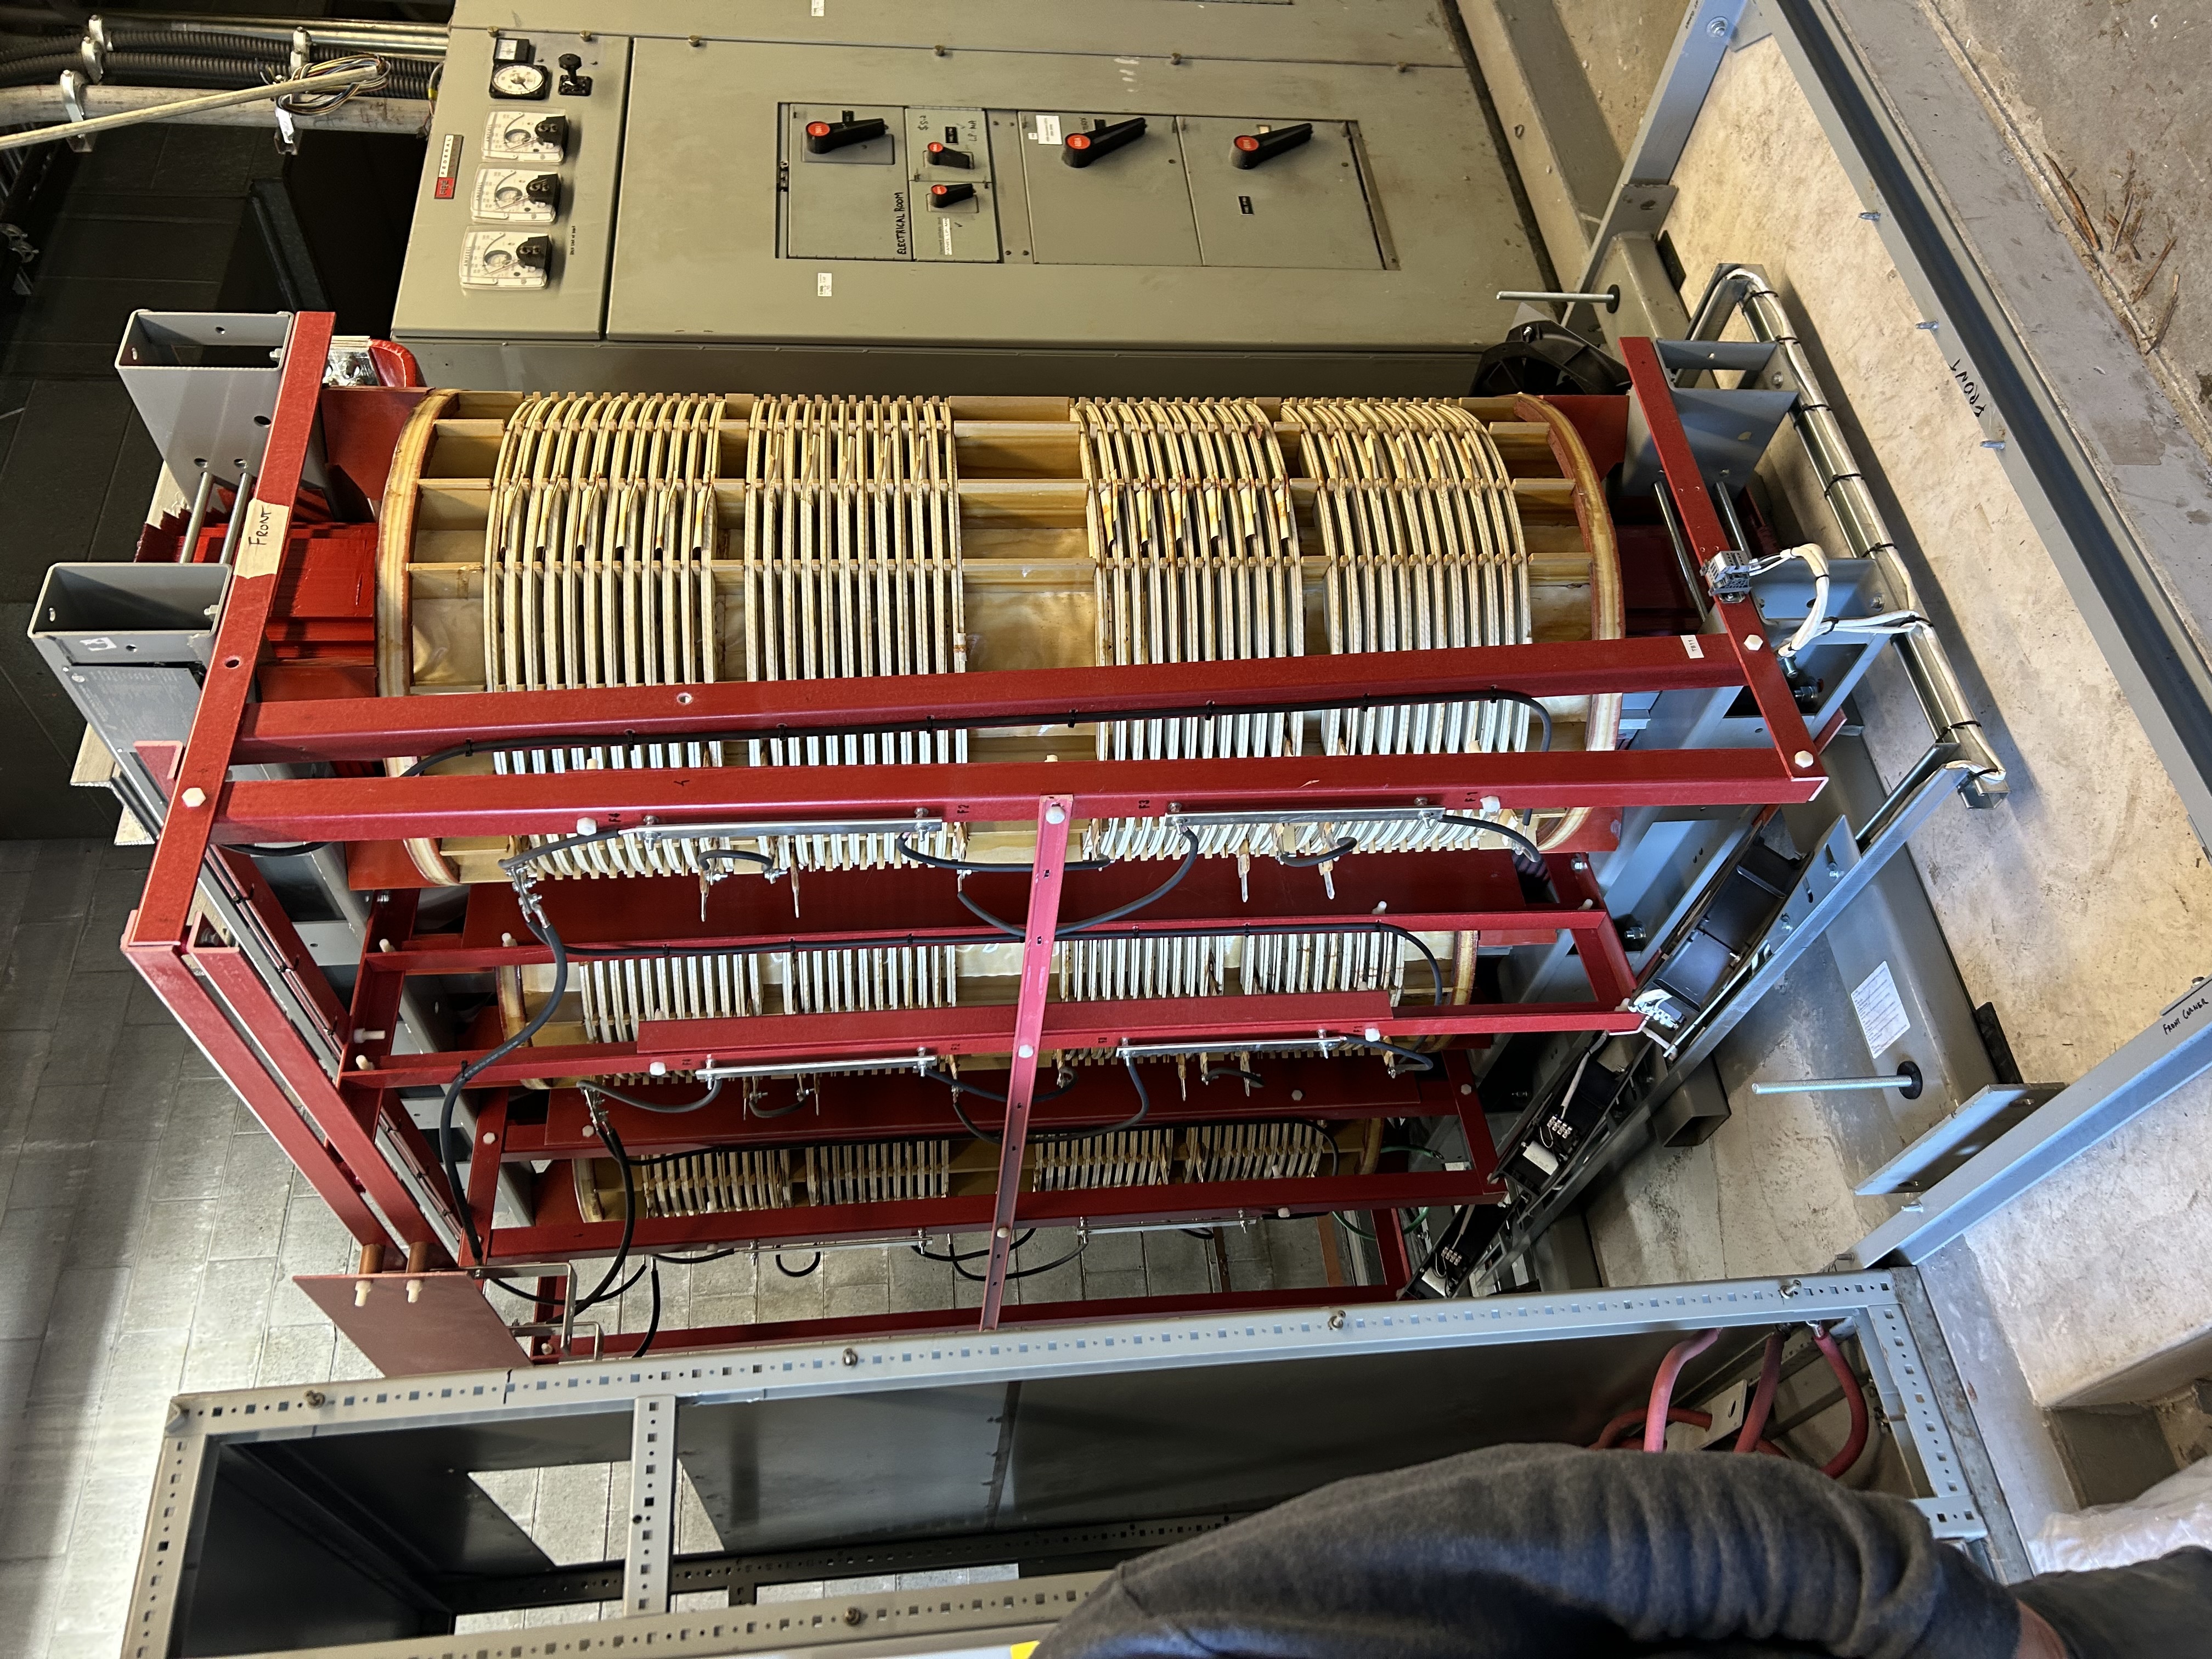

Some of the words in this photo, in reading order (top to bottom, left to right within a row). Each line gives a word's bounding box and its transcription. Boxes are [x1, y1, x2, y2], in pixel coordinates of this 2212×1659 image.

[441, 138, 451, 174] FEDERAL
[894, 192, 905, 212] ROOM
[896, 213, 906, 254] ELECTRICAL
[1948, 358, 1987, 418] FRONT
[248, 505, 272, 545] FRONT
[1688, 639, 1697, 652] TB11
[1138, 800, 1150, 809] F3
[1464, 792, 1478, 802] F1
[608, 812, 622, 822] F4
[957, 804, 969, 814] F2
[2163, 1018, 2181, 1035] FRONT
[2182, 998, 2209, 1019] CORNER
